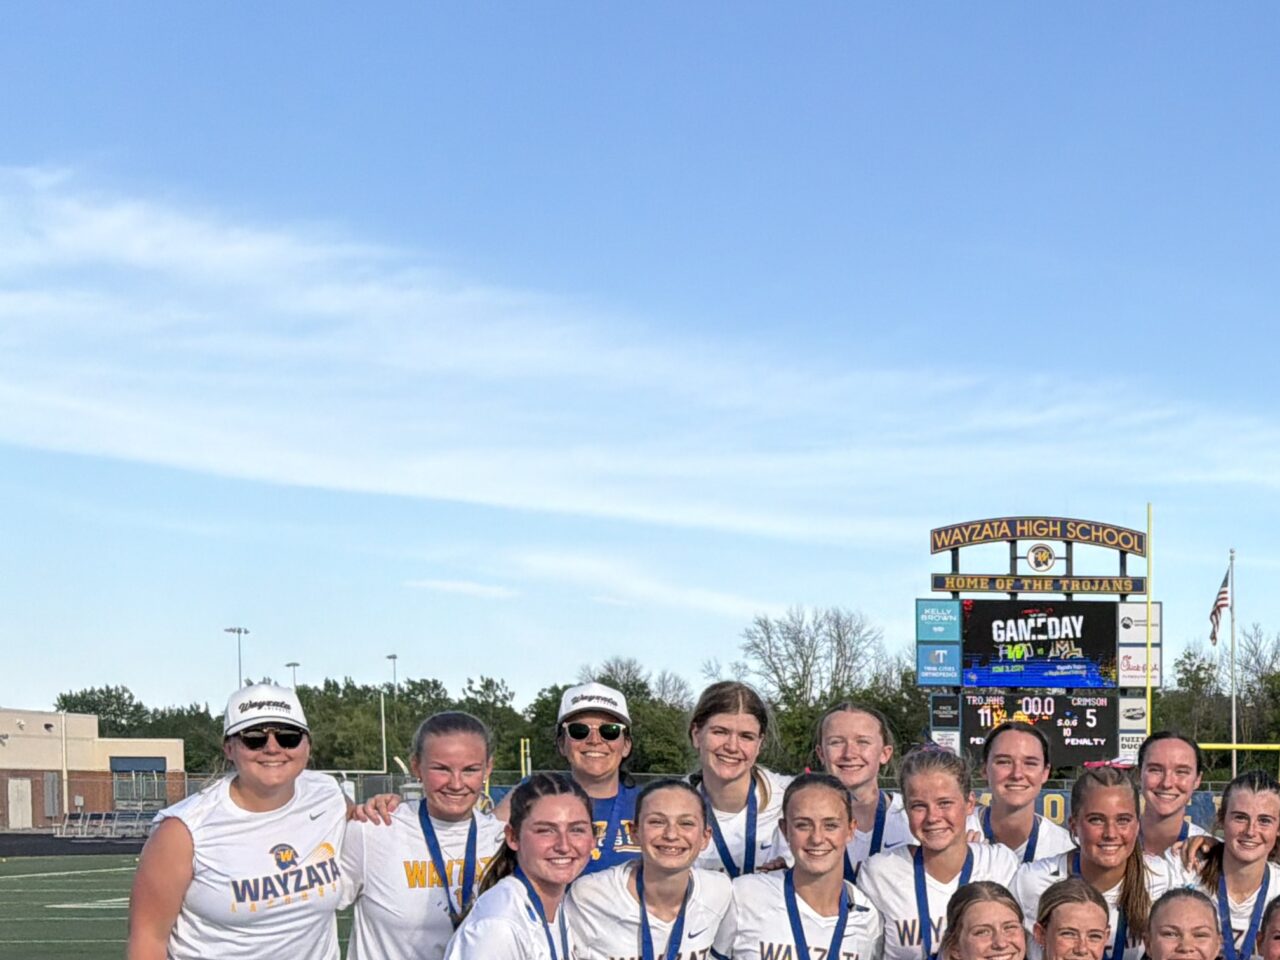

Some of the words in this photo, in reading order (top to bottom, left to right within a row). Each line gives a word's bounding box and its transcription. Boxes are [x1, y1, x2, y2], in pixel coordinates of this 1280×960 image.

[934, 520, 1011, 549] WAYZATA
[1016, 519, 1061, 537] HIGH
[1066, 521, 1143, 552] SCHOOL
[944, 577, 989, 590] HOME
[995, 578, 1013, 590] OF
[1018, 577, 1053, 591] THE
[1060, 578, 1133, 592] TROJANS
[966, 695, 1005, 705] TROJANS
[1022, 696, 1054, 715] 00.0
[1071, 697, 1107, 707] CRIMSON
[1086, 708, 1097, 728] 5
[1065, 738, 1106, 746] PENALTY
[231, 857, 341, 903] WAYZATA
